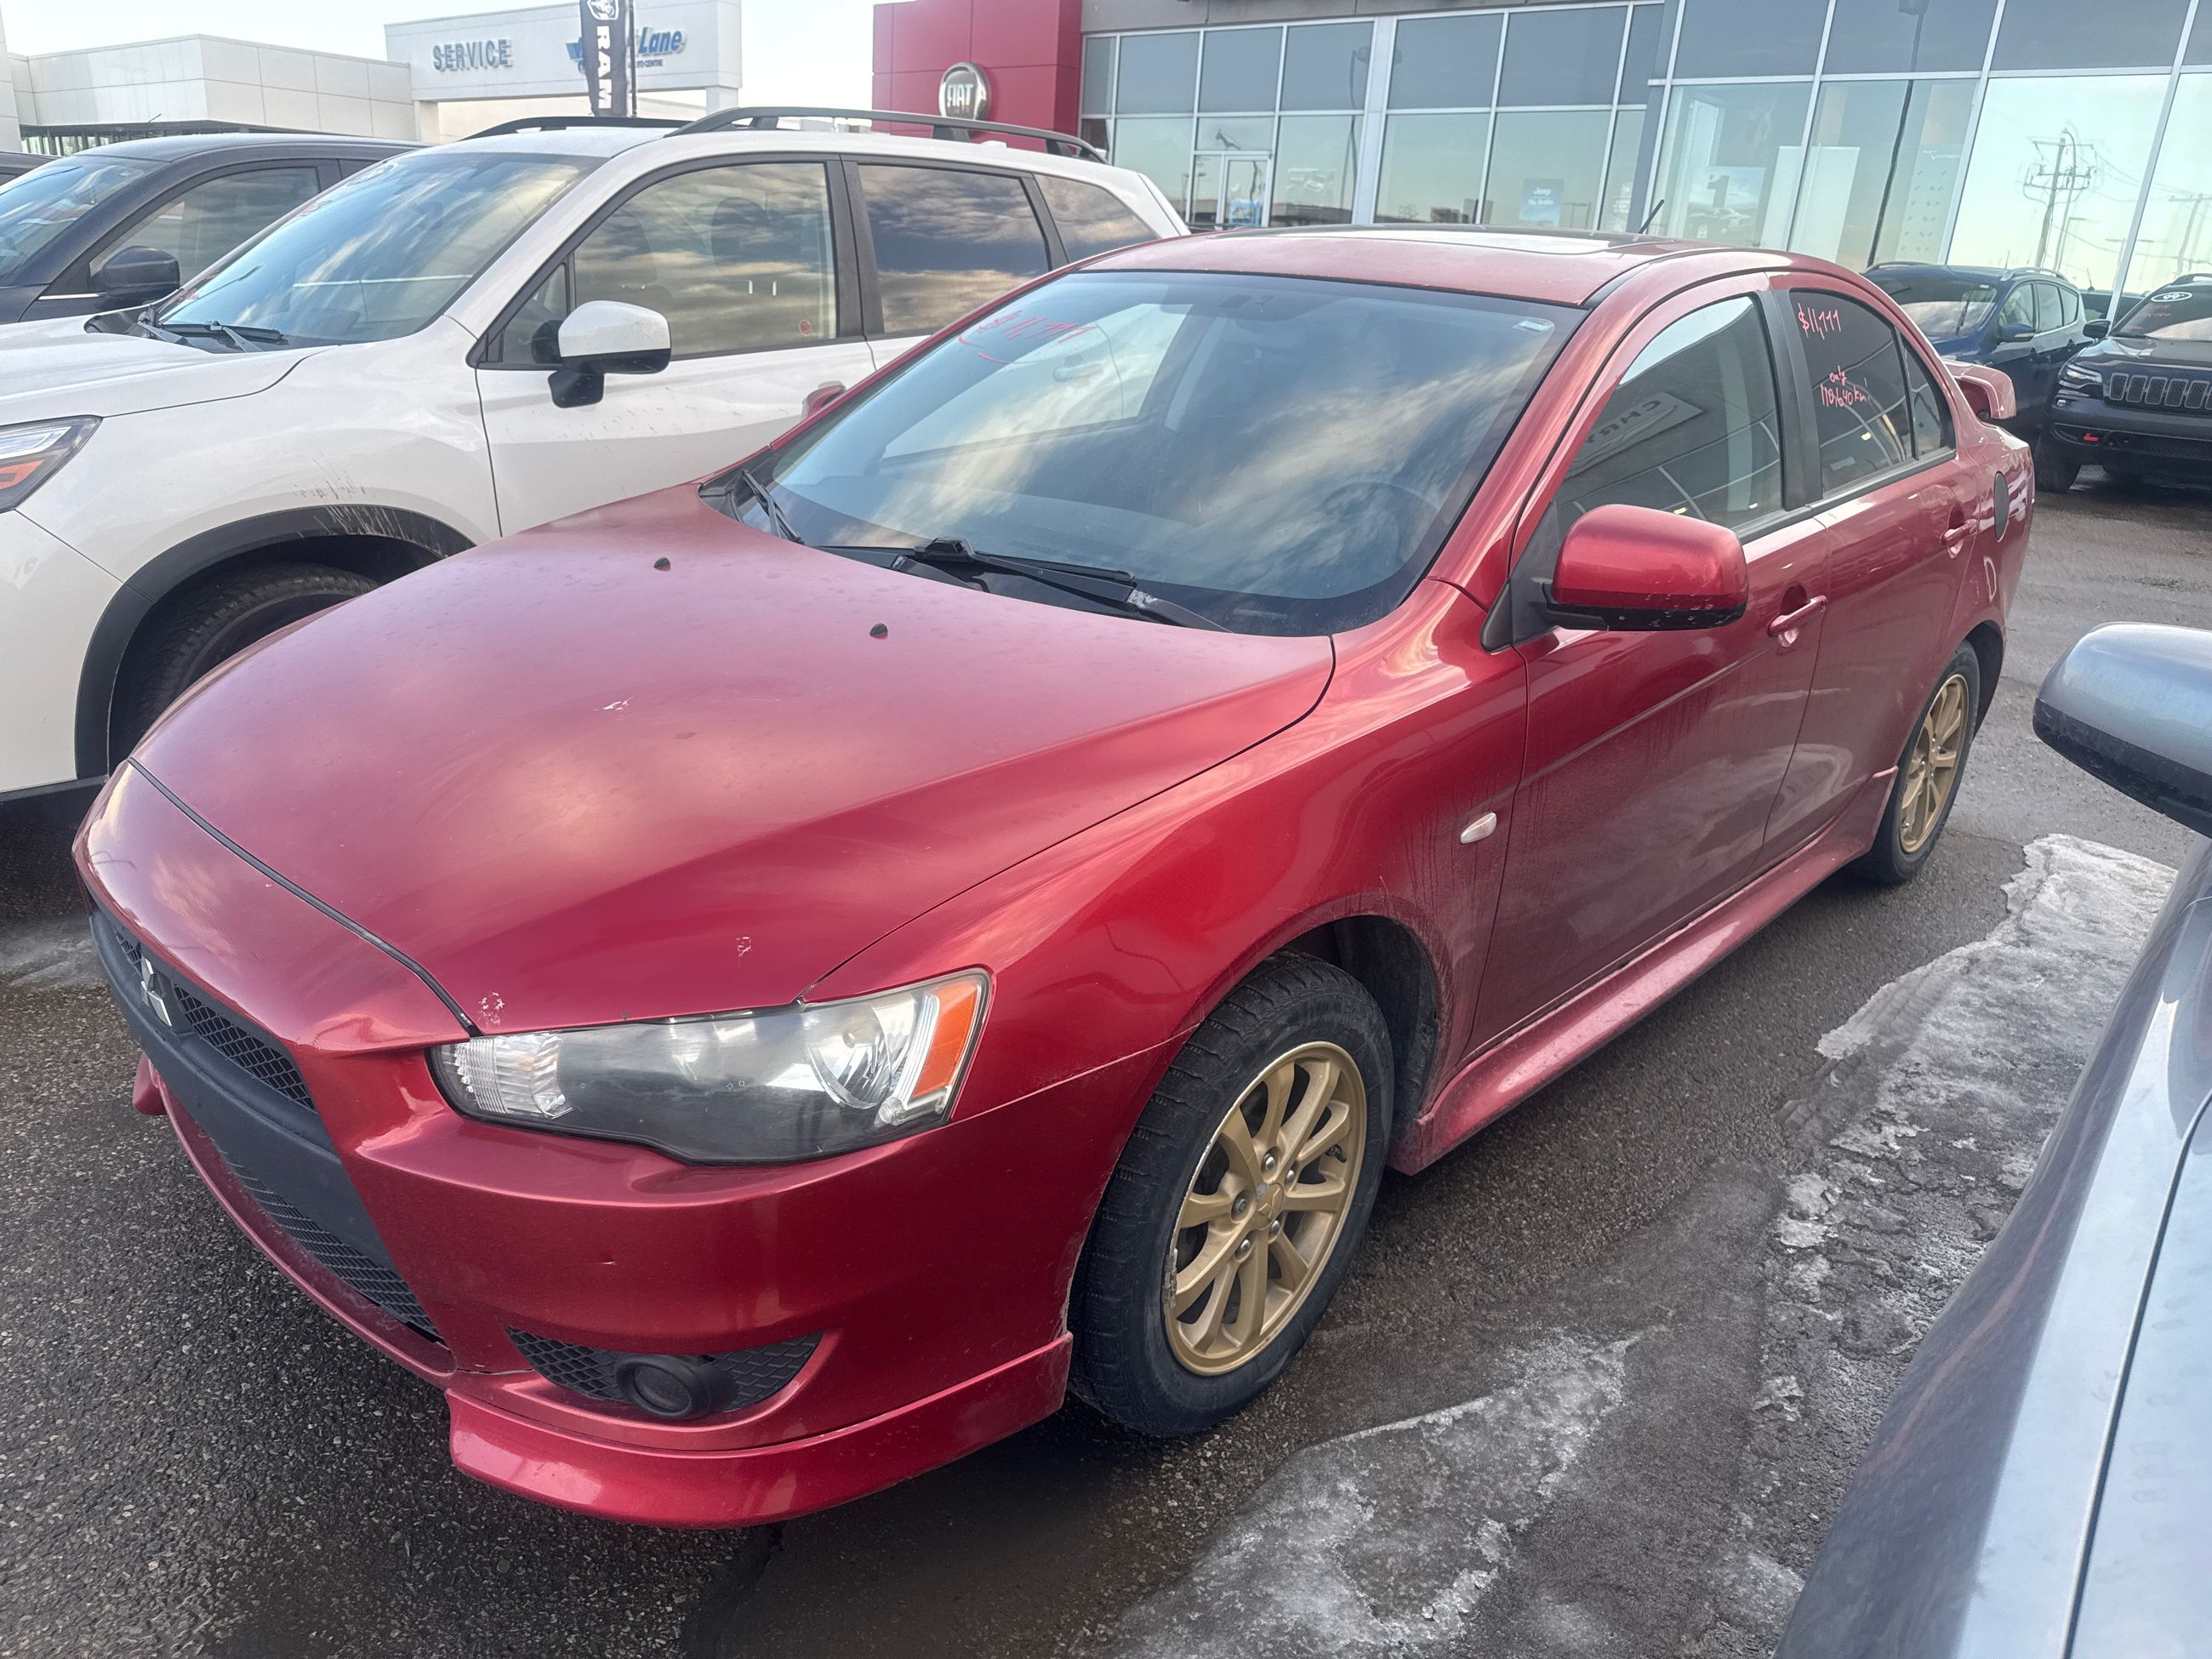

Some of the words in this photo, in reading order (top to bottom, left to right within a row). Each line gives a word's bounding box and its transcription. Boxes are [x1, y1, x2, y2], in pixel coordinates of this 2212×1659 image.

[433, 39, 512, 71] SERVICE
[637, 26, 686, 55] Lane
[596, 26, 612, 109] RAM
[947, 83, 973, 109] FIAT
[1829, 365, 1848, 386] only
